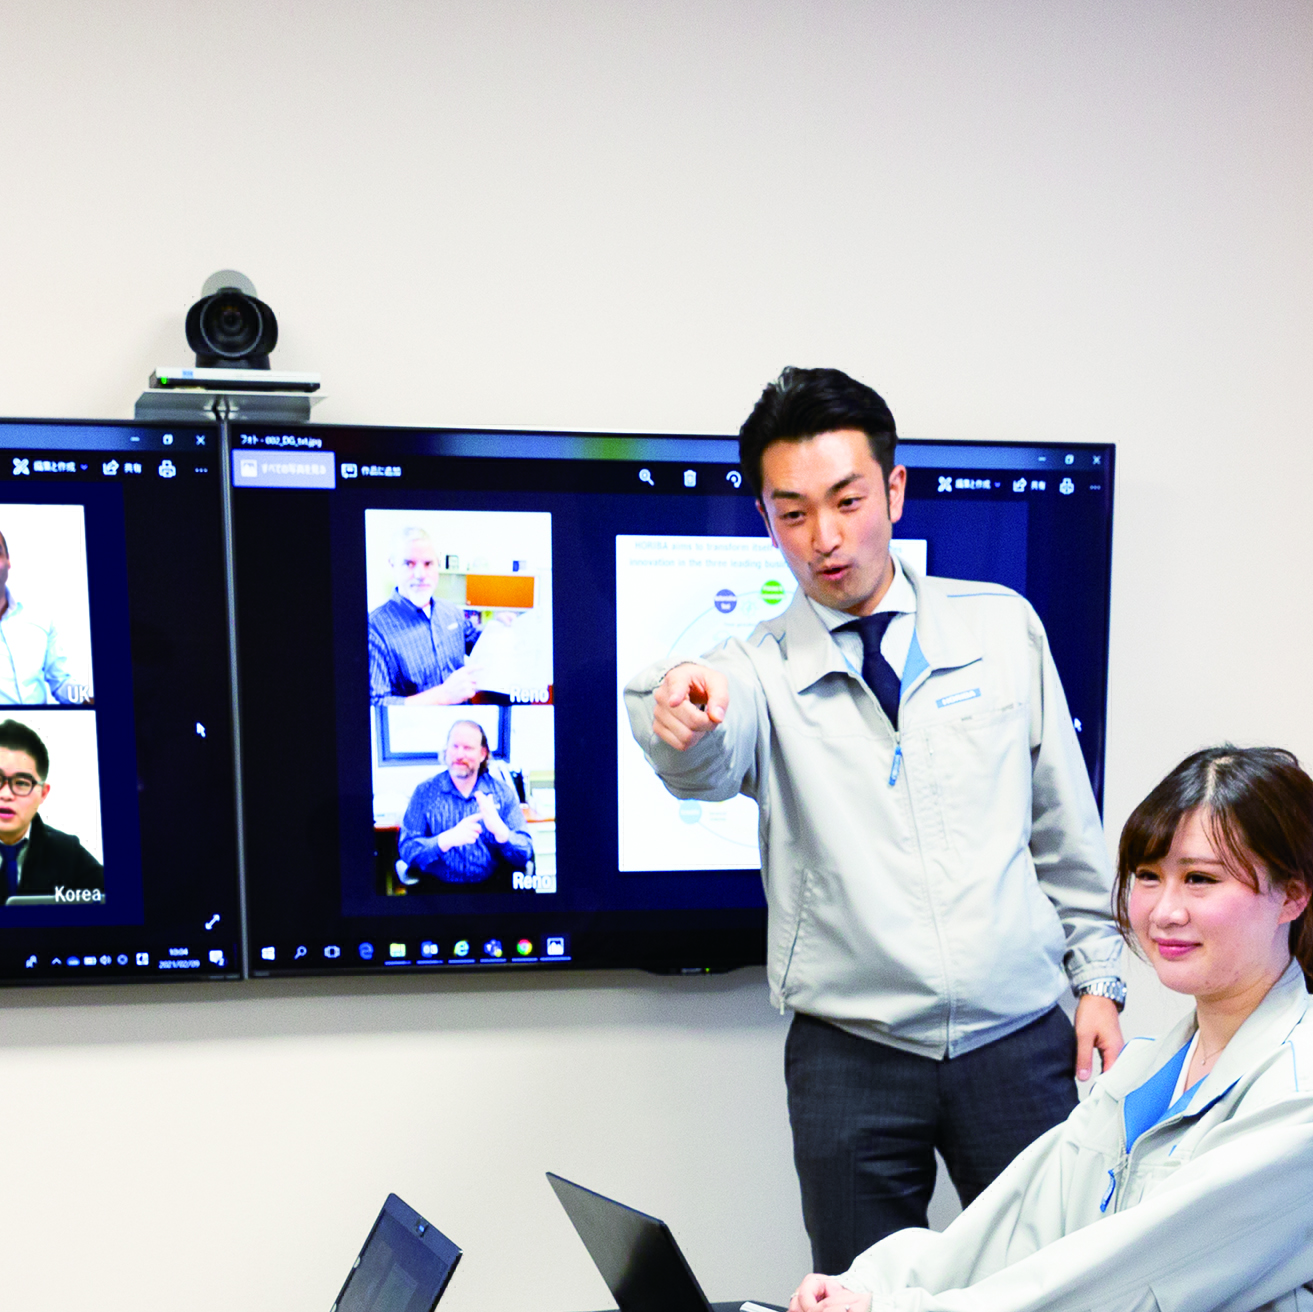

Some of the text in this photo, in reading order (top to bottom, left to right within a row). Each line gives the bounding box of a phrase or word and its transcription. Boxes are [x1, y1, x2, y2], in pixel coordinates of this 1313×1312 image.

[635, 541, 668, 551] HORIBA
[672, 542, 692, 551] aims
[695, 542, 704, 551] to
[706, 542, 749, 552] transform
[629, 557, 675, 567] innovation
[689, 558, 702, 568] the
[705, 558, 727, 568] three
[730, 559, 761, 570] leading
[67, 685, 91, 703] UK
[509, 687, 549, 704] Reno
[512, 872, 551, 890] Reno
[54, 885, 102, 903] Korea
